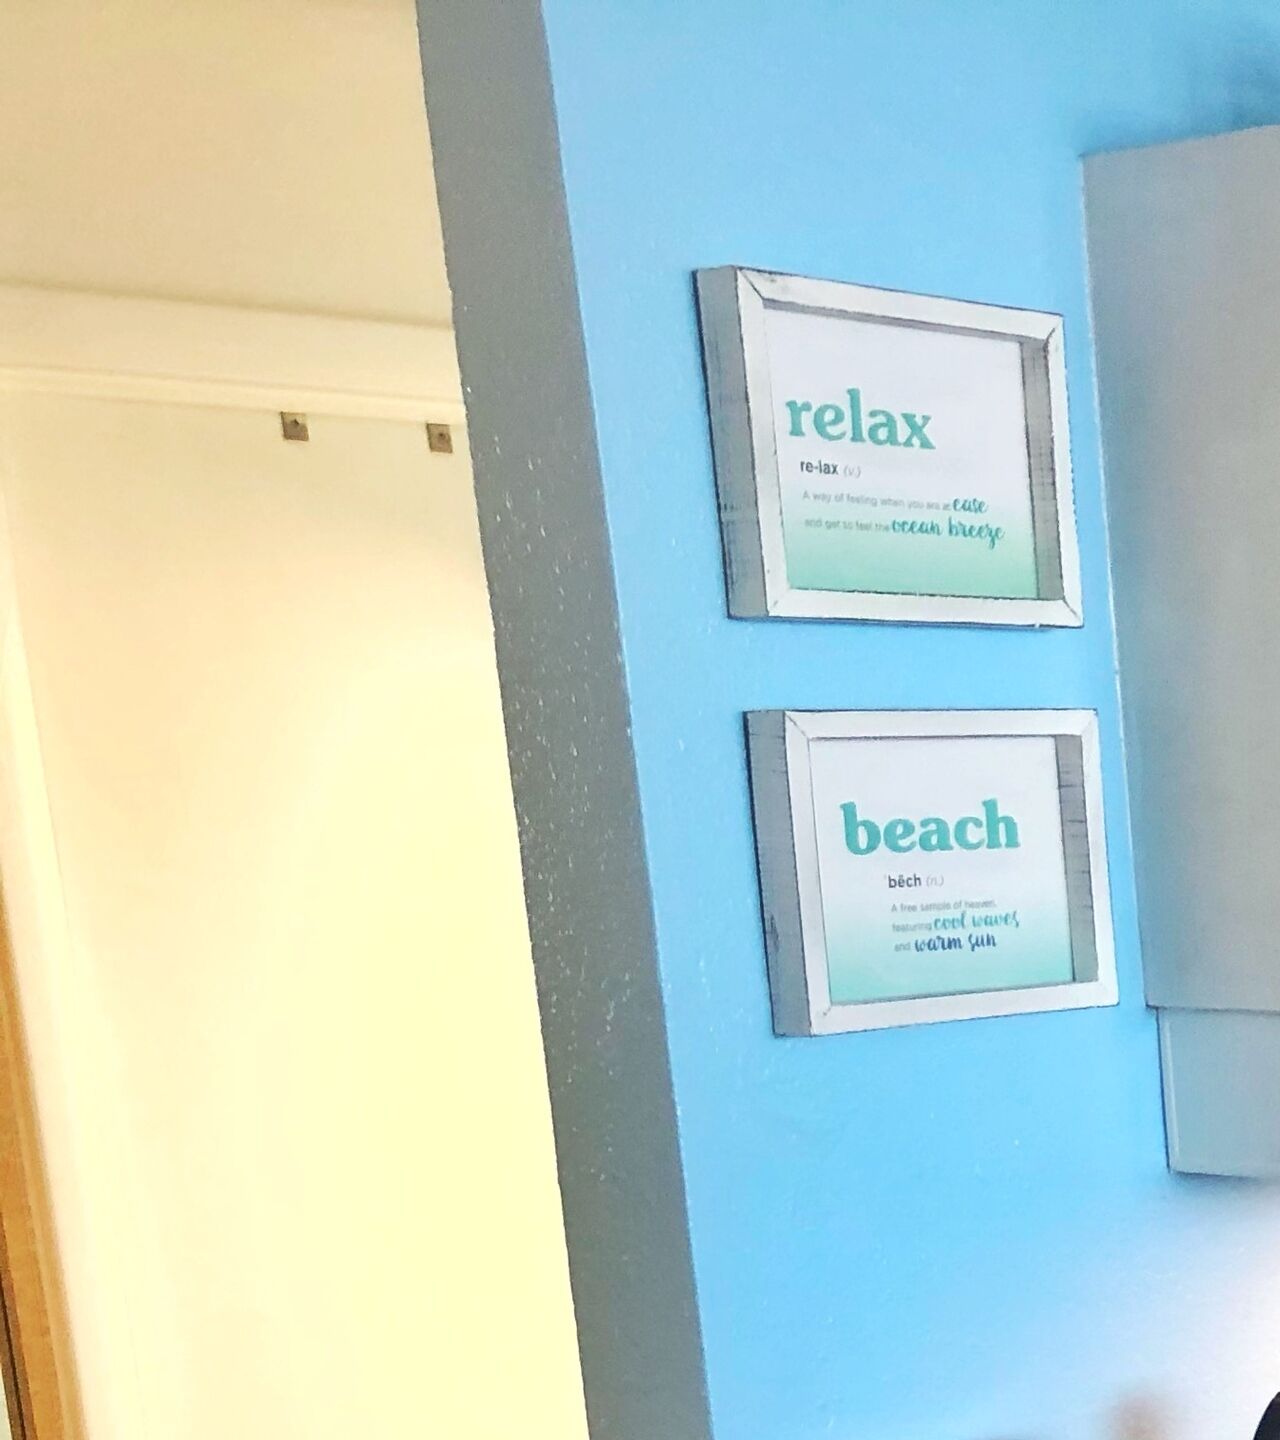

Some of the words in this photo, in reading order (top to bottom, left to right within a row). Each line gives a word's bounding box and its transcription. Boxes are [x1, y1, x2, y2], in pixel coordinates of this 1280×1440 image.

[786, 387, 937, 450] relax
[800, 459, 839, 475] re-lax
[892, 519, 942, 536] ocean
[948, 515, 1005, 550] breeze
[840, 798, 1021, 856] beach
[934, 910, 966, 931] cool
[972, 910, 1020, 928] waves
[915, 935, 963, 953] warm
[968, 933, 997, 952] sun
